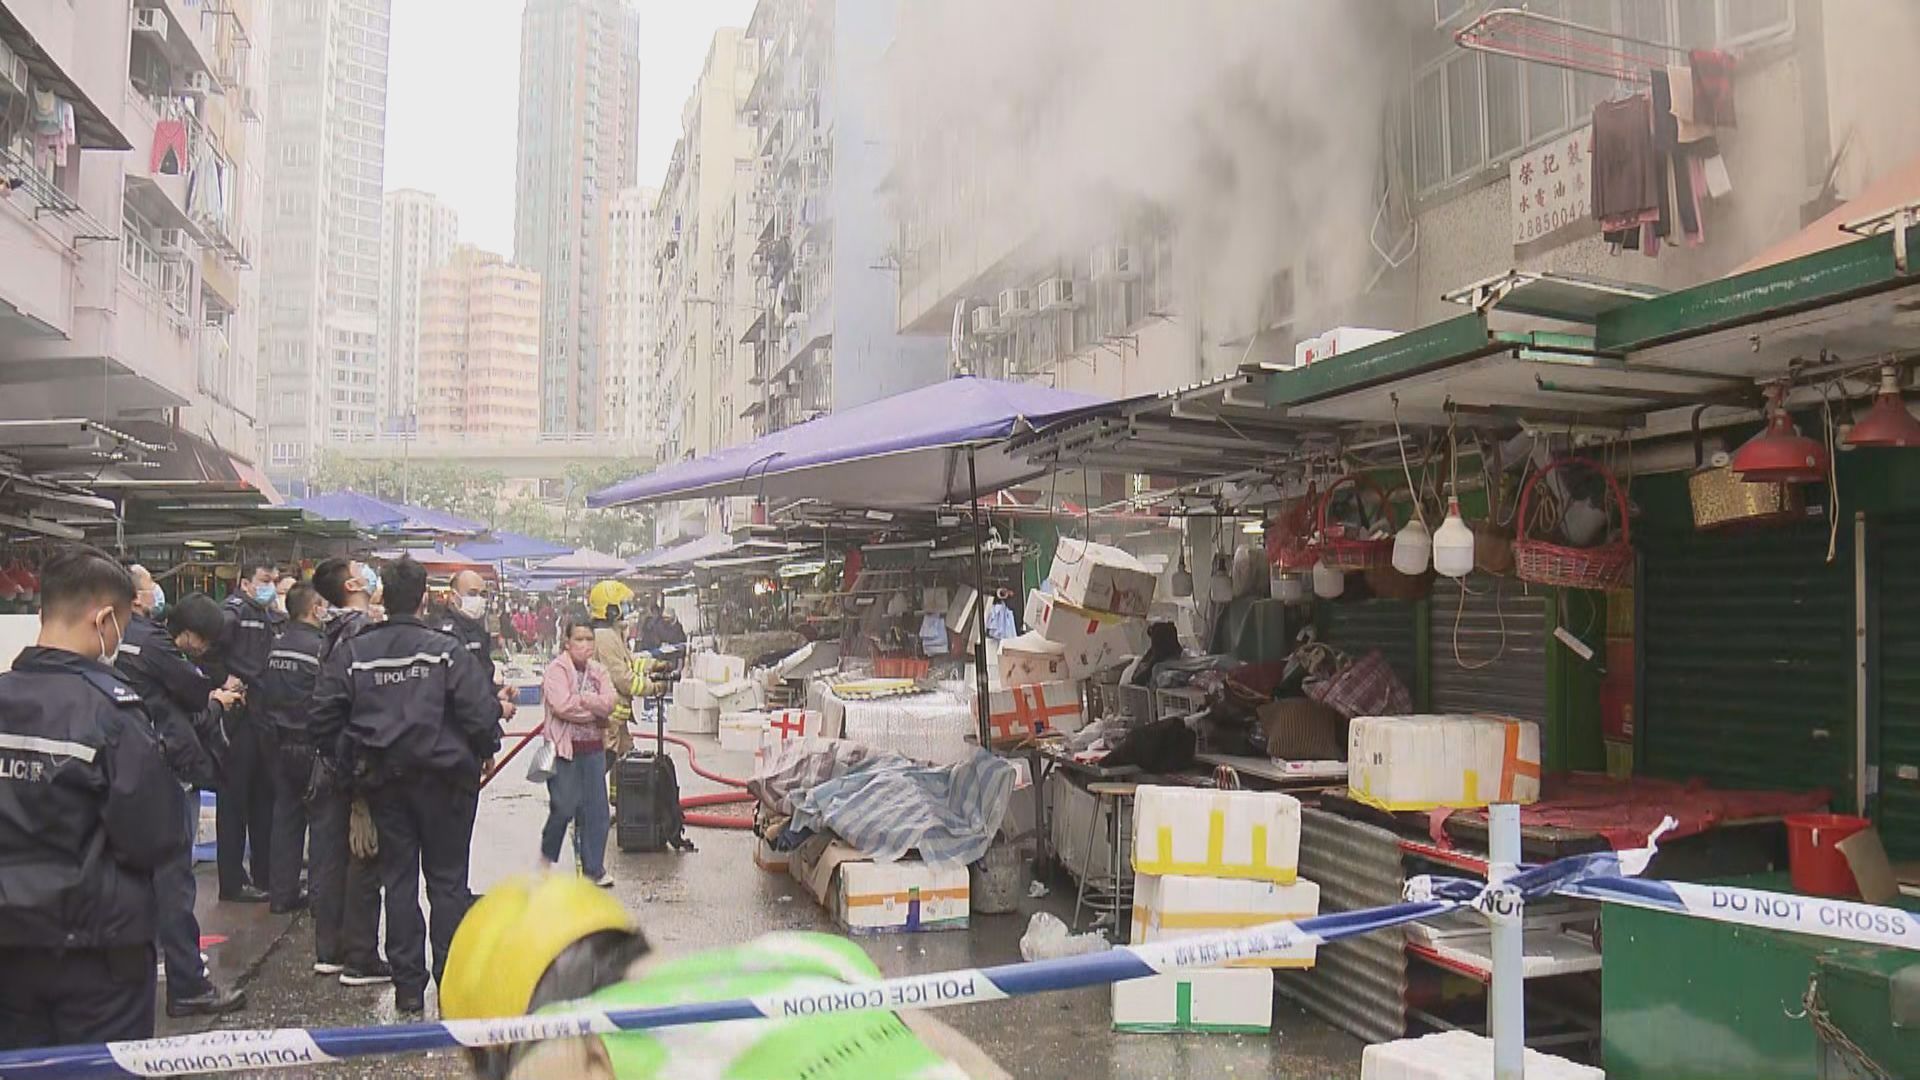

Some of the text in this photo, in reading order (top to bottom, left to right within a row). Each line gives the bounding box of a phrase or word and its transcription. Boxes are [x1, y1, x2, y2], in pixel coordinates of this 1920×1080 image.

[1518, 199, 1585, 240] 28850042
[1712, 891, 1906, 935] DO NOT CROSS
[783, 977, 975, 1016] POLICE CORDON
[144, 1047, 313, 1073] POLICE CORDON
